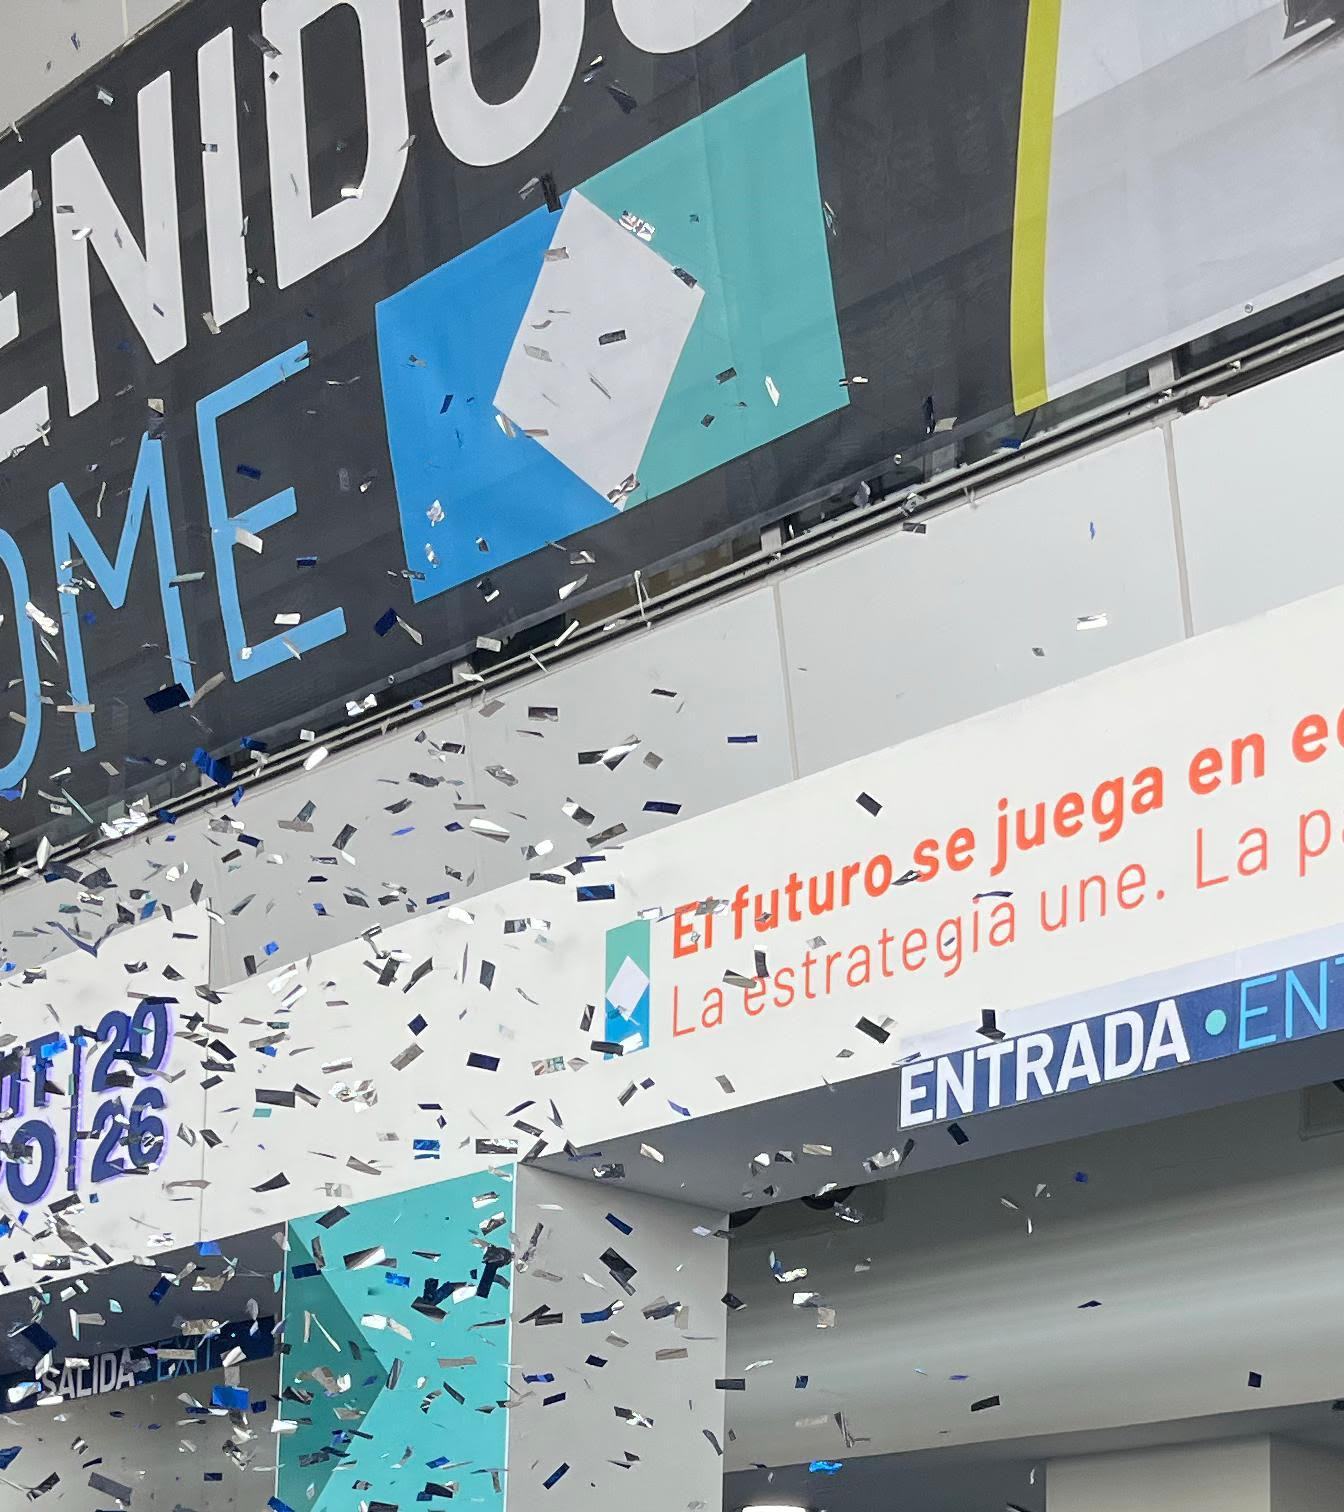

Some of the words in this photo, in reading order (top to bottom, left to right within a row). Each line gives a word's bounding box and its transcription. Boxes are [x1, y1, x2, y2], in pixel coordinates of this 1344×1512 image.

[673, 897, 715, 959] El
[731, 853, 894, 940] futuro
[913, 826, 977, 884] se
[989, 765, 1165, 877] juega
[1188, 732, 1266, 796] en
[672, 985, 724, 1038] La
[743, 900, 1017, 1017] estrategia
[1039, 863, 1166, 933] une.
[1195, 827, 1269, 889] La
[91, 996, 169, 1093] 20
[900, 1000, 1190, 1129] ENTRADA
[90, 1087, 166, 1184] 26
